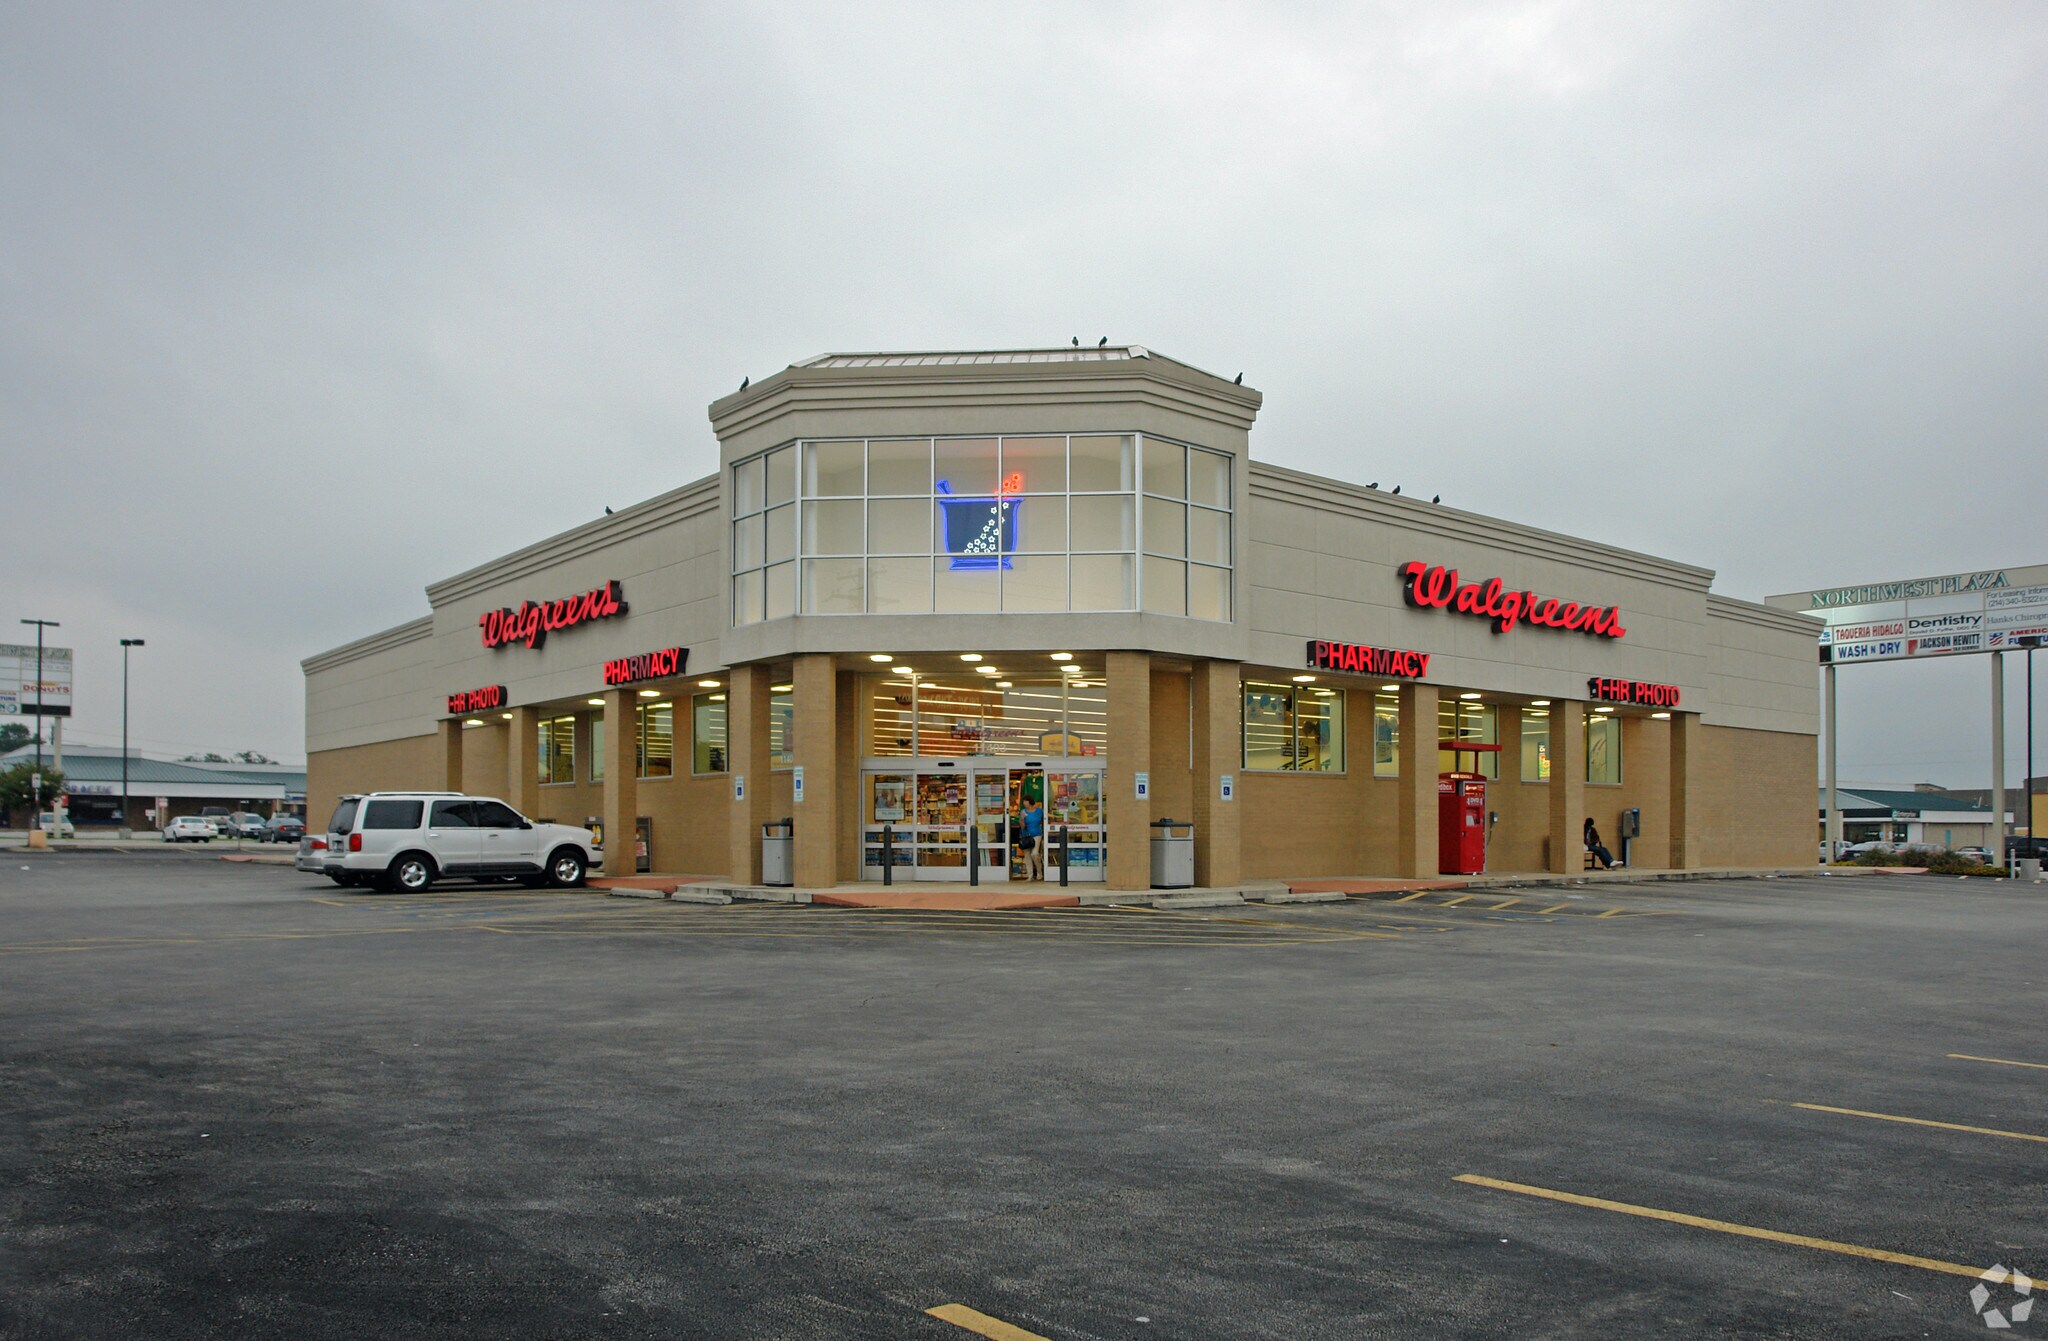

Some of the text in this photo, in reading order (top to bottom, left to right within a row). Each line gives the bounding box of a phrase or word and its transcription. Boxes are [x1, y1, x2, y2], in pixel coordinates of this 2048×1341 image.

[1405, 561, 1627, 639] Walgreens
[1811, 571, 2010, 608] NORTHWEST PLAZA
[479, 579, 621, 649] Walgreens
[1908, 615, 1983, 629] Dentistry
[1835, 626, 1871, 640] TAQUERIA
[1872, 623, 1904, 637] HIDALGO
[1920, 633, 1981, 649] JACKSON HEWITT
[1314, 641, 1430, 678] PHARMACY
[1838, 645, 1868, 658] WASH
[1879, 641, 1901, 655] DRY
[603, 647, 682, 685] PHARMACY
[468, 685, 500, 711] PHOTO
[1595, 677, 1681, 706] 1-HR PHOTO
